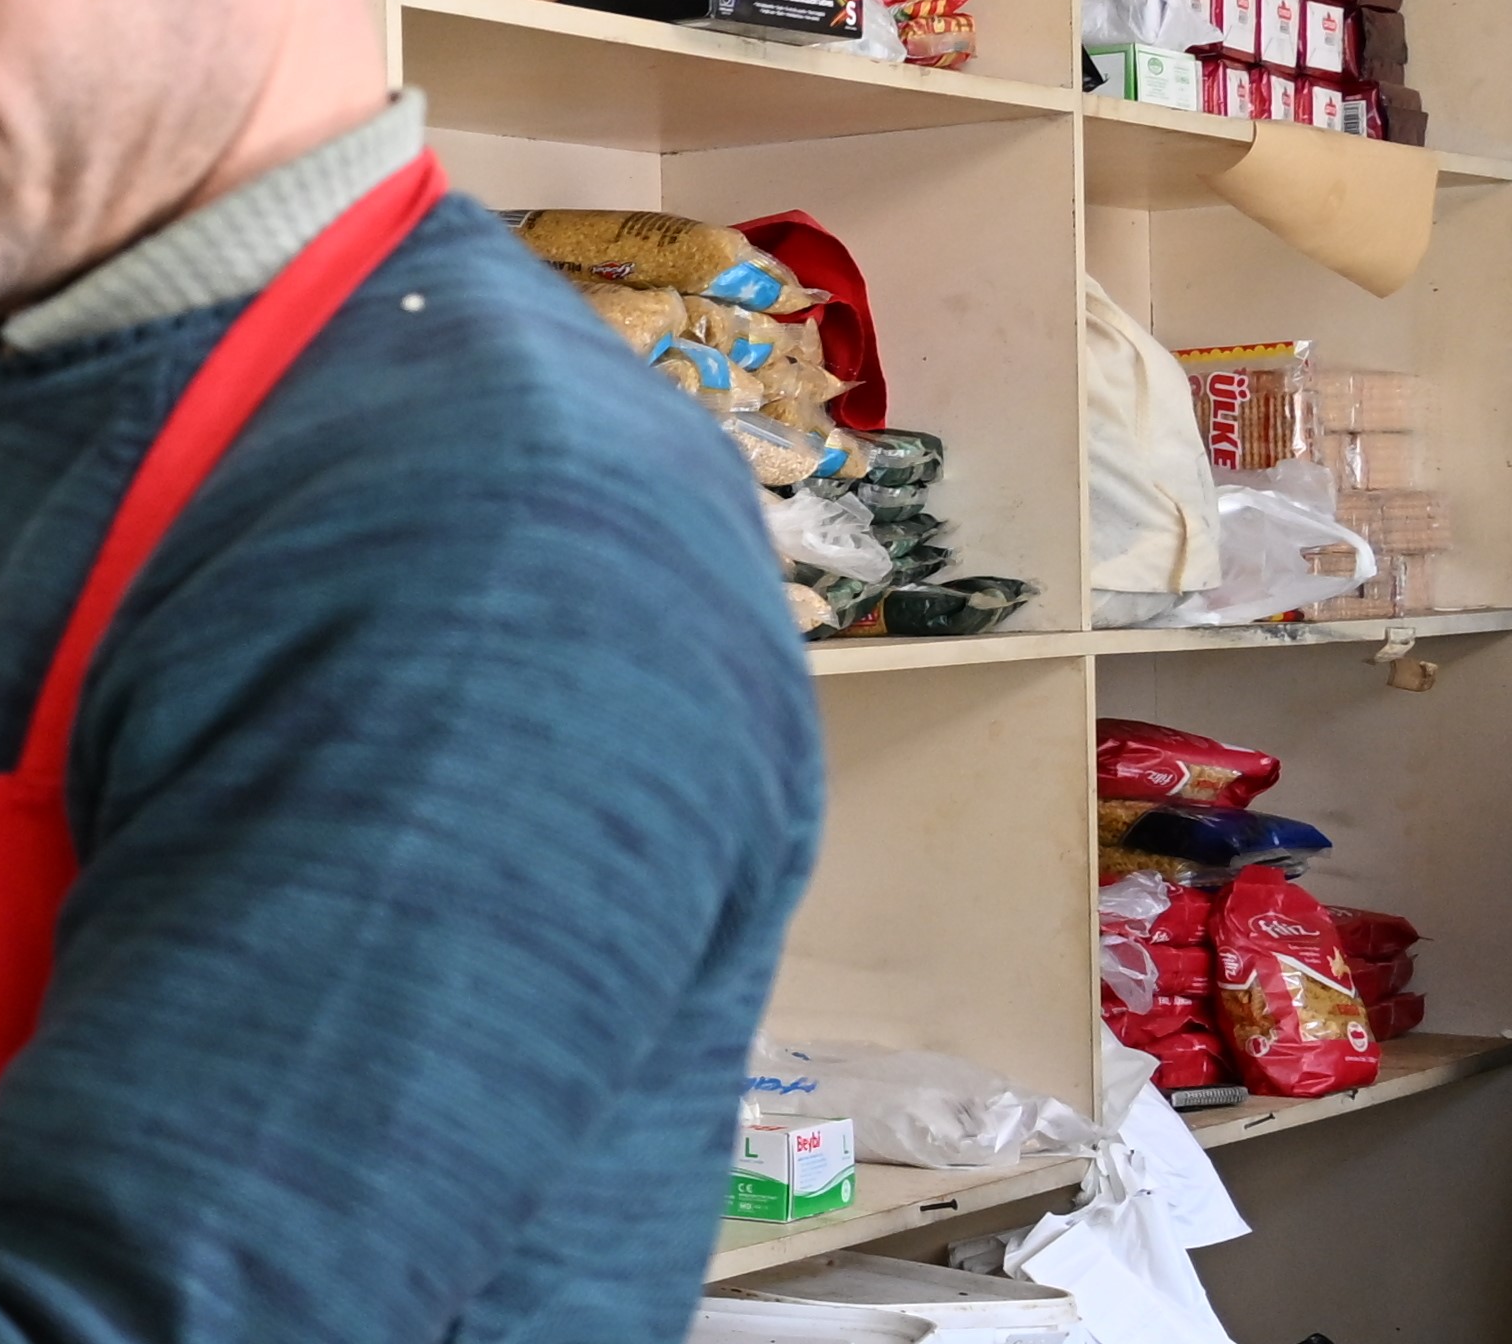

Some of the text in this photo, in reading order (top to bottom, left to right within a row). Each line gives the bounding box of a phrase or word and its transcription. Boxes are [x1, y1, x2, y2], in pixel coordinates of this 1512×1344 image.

[845, 0, 857, 26] S
[1206, 371, 1251, 471] ÜLKE
[745, 1137, 759, 1158] L
[796, 1131, 821, 1154] Beybi
